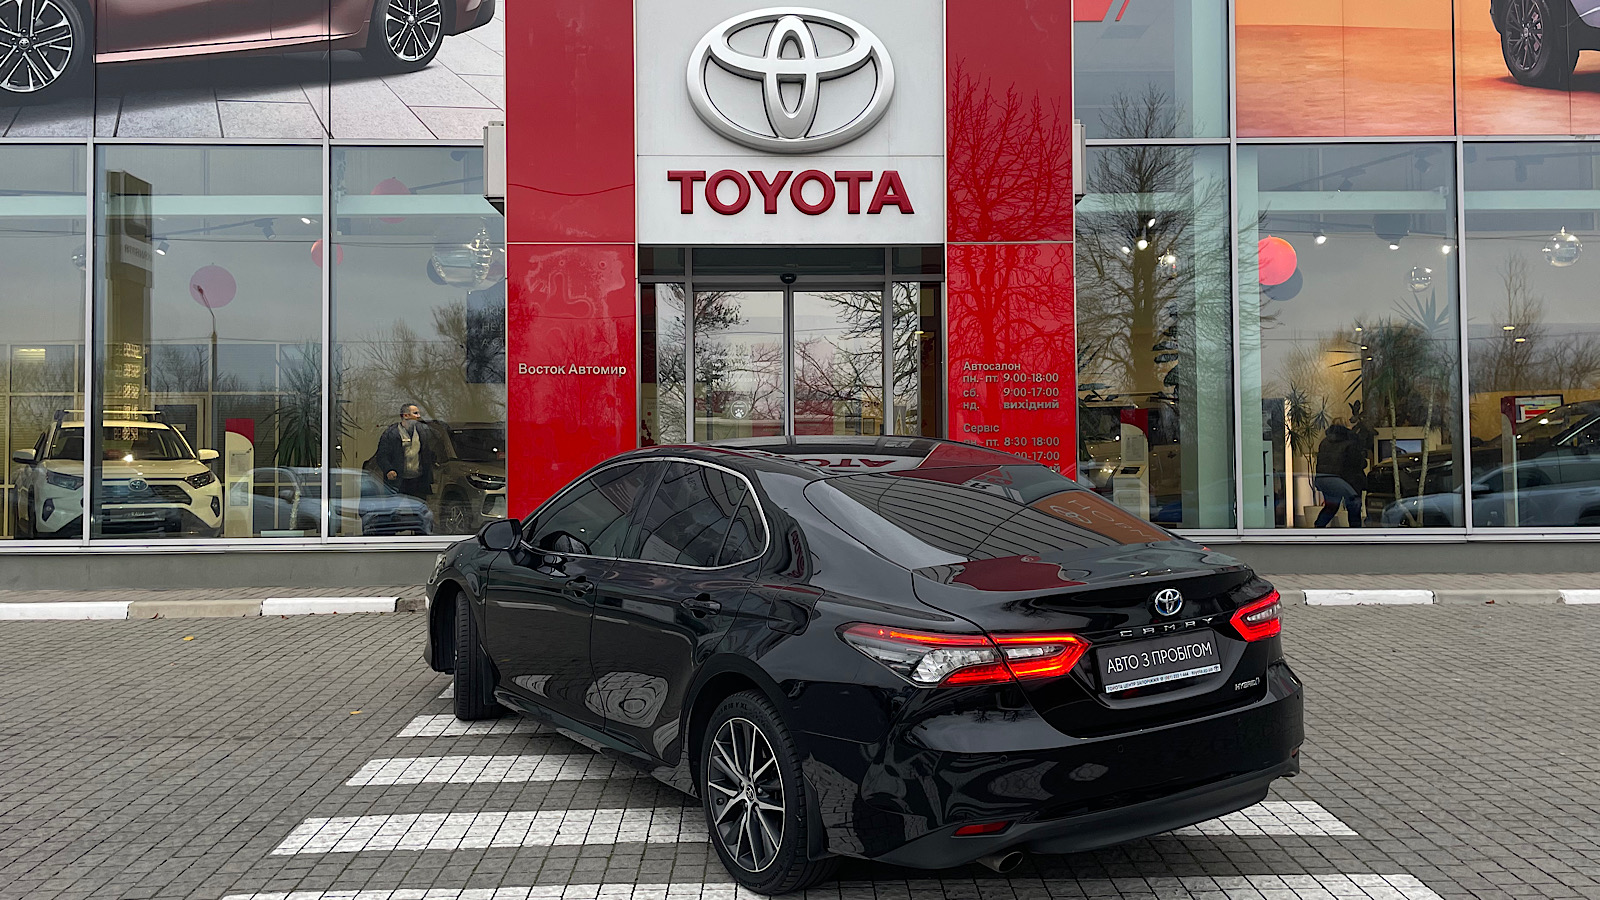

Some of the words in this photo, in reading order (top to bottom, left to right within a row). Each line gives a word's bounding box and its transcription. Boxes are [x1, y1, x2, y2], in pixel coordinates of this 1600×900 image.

[667, 169, 915, 216] TOYOTA
[518, 363, 566, 375] Восток
[568, 363, 627, 378] Автомир
[963, 361, 1021, 371] Автосалон
[963, 388, 979, 397] сб.
[963, 402, 980, 411] нд.
[1003, 399, 1060, 410] вихідний
[963, 423, 1000, 434] Сервіс
[985, 439, 1000, 447] пт.
[1004, 436, 1028, 446] 8:30
[1031, 436, 1060, 446] 18:00
[1119, 617, 1213, 637] CAMRY
[1106, 654, 1140, 674] АВТО
[1152, 641, 1213, 666] ПРОБІГОМ
